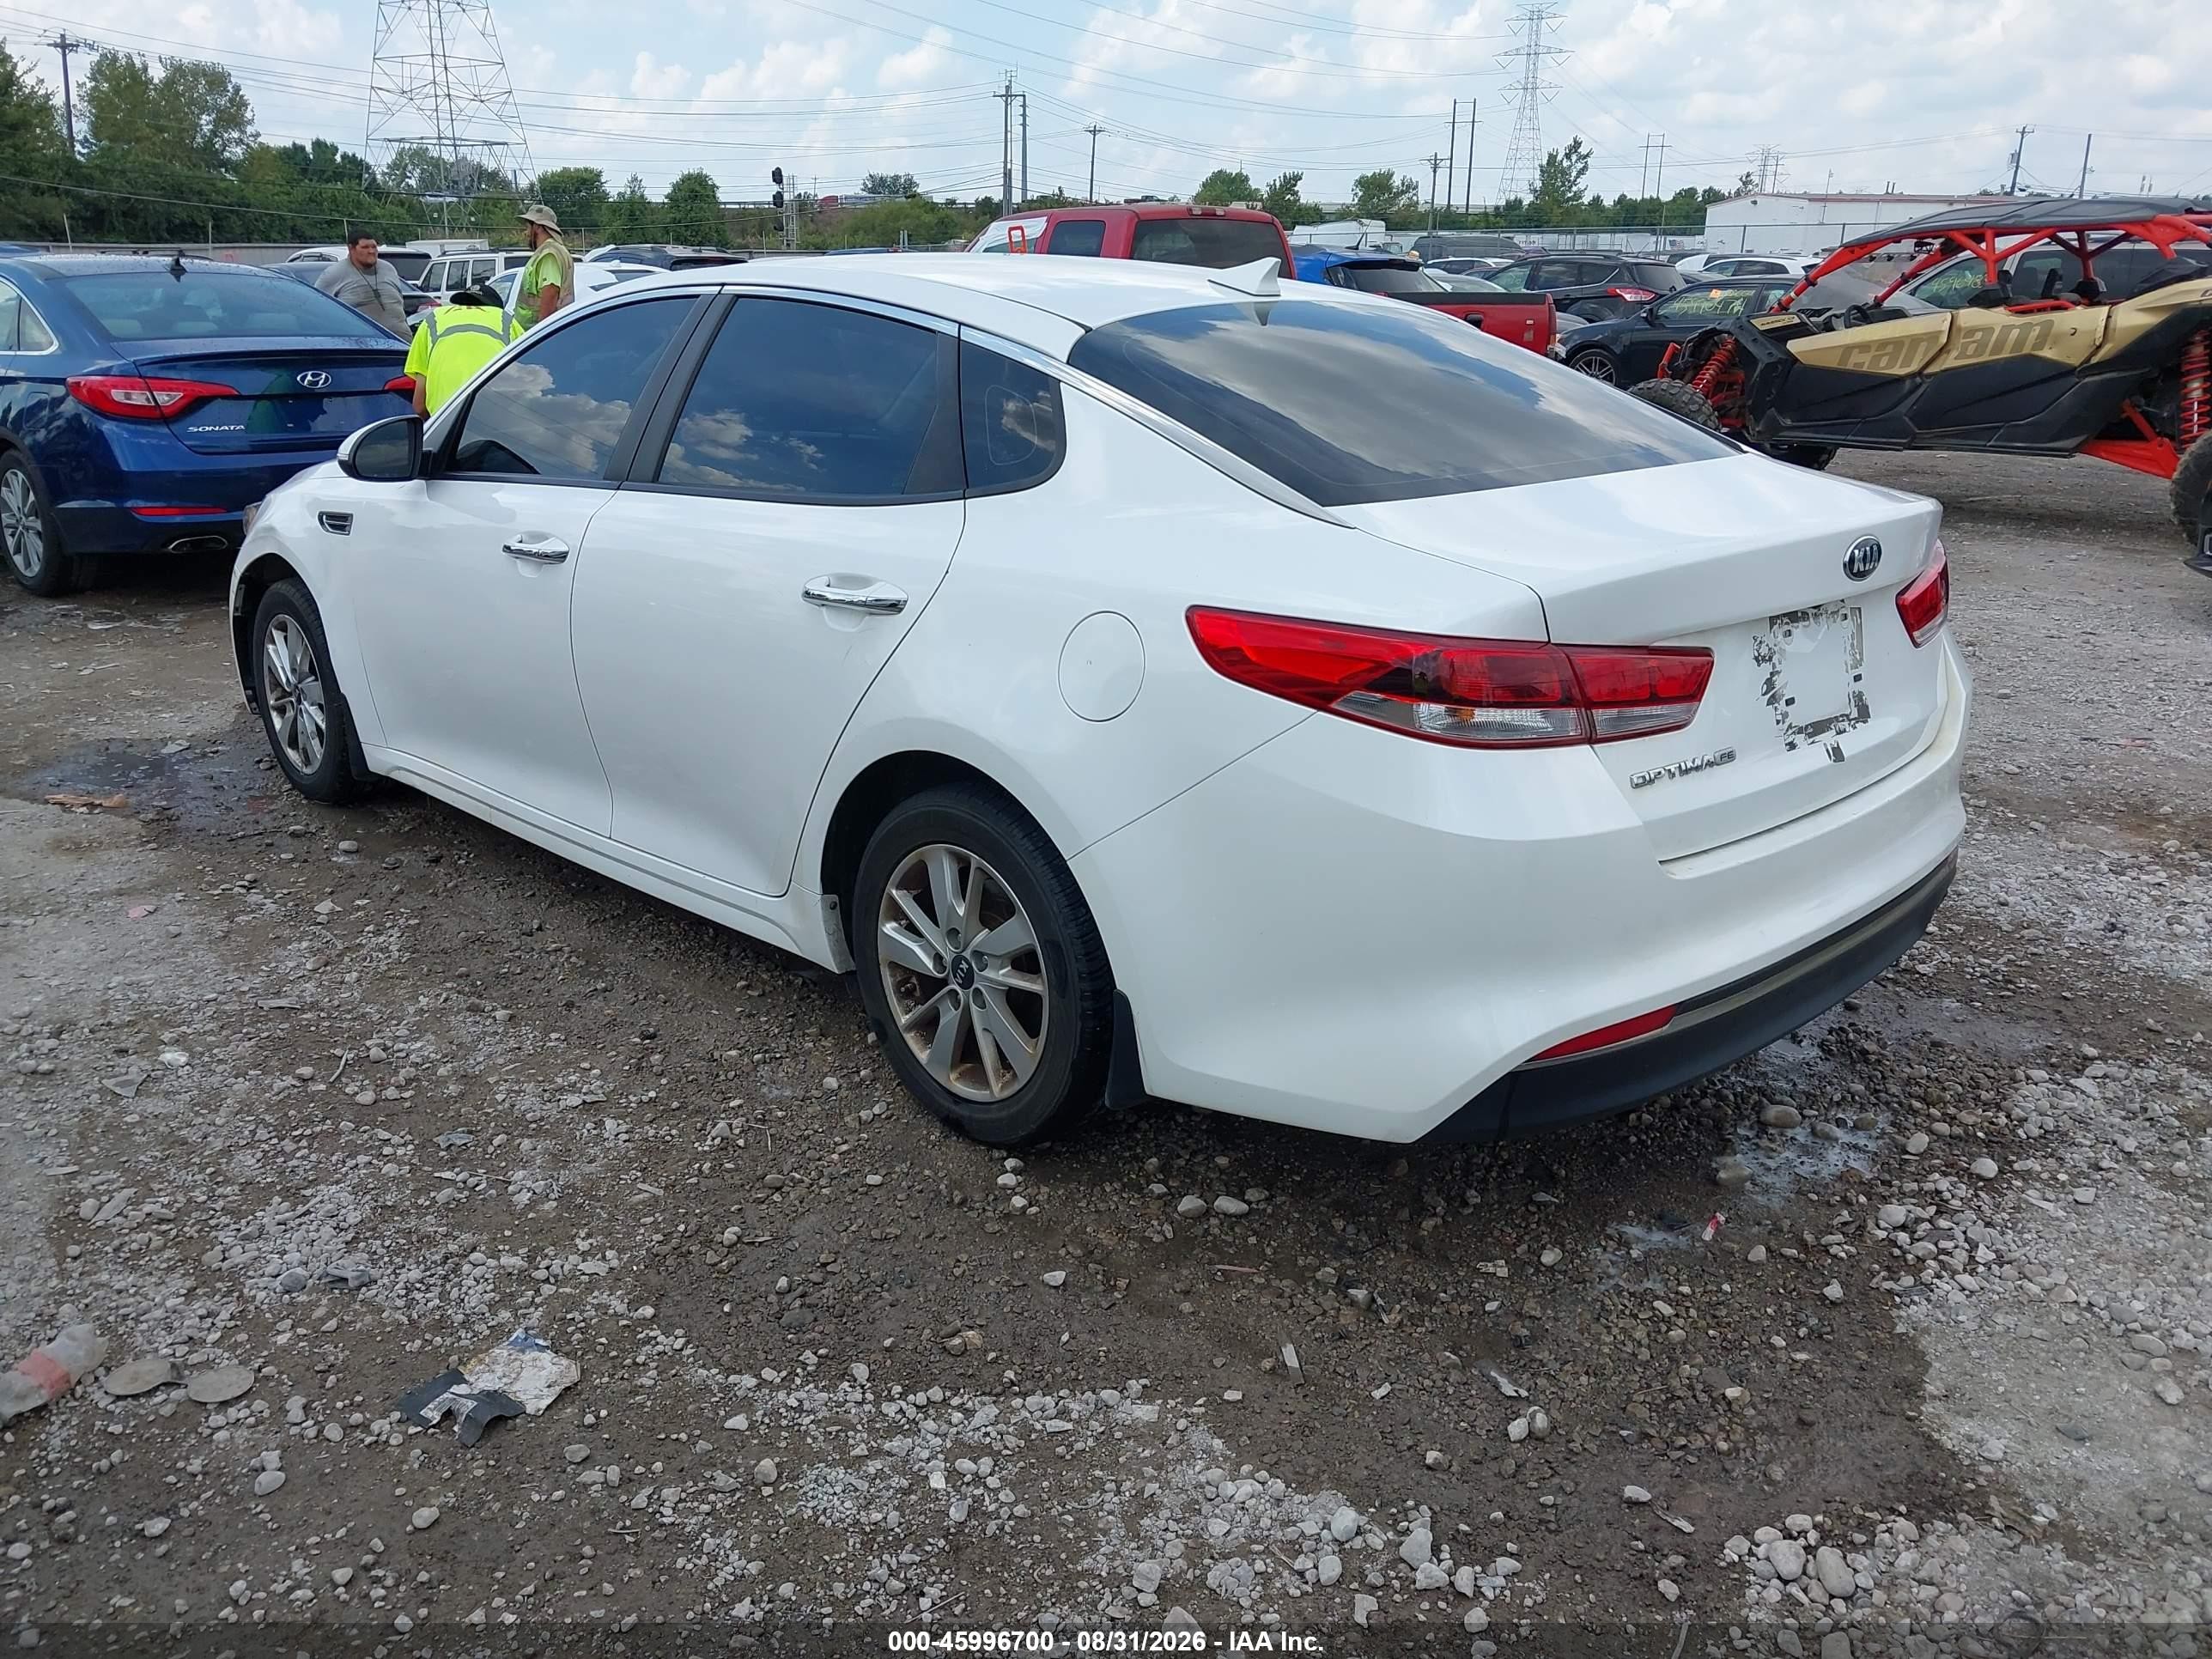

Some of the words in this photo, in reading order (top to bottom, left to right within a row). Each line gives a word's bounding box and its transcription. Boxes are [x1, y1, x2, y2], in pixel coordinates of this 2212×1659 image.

[186, 424, 246, 433] SONATA
[1852, 544, 1879, 573] KIA
[1629, 754, 1715, 789] OPTIMA
[1718, 749, 1735, 763] FE
[954, 960, 969, 984] KIA
